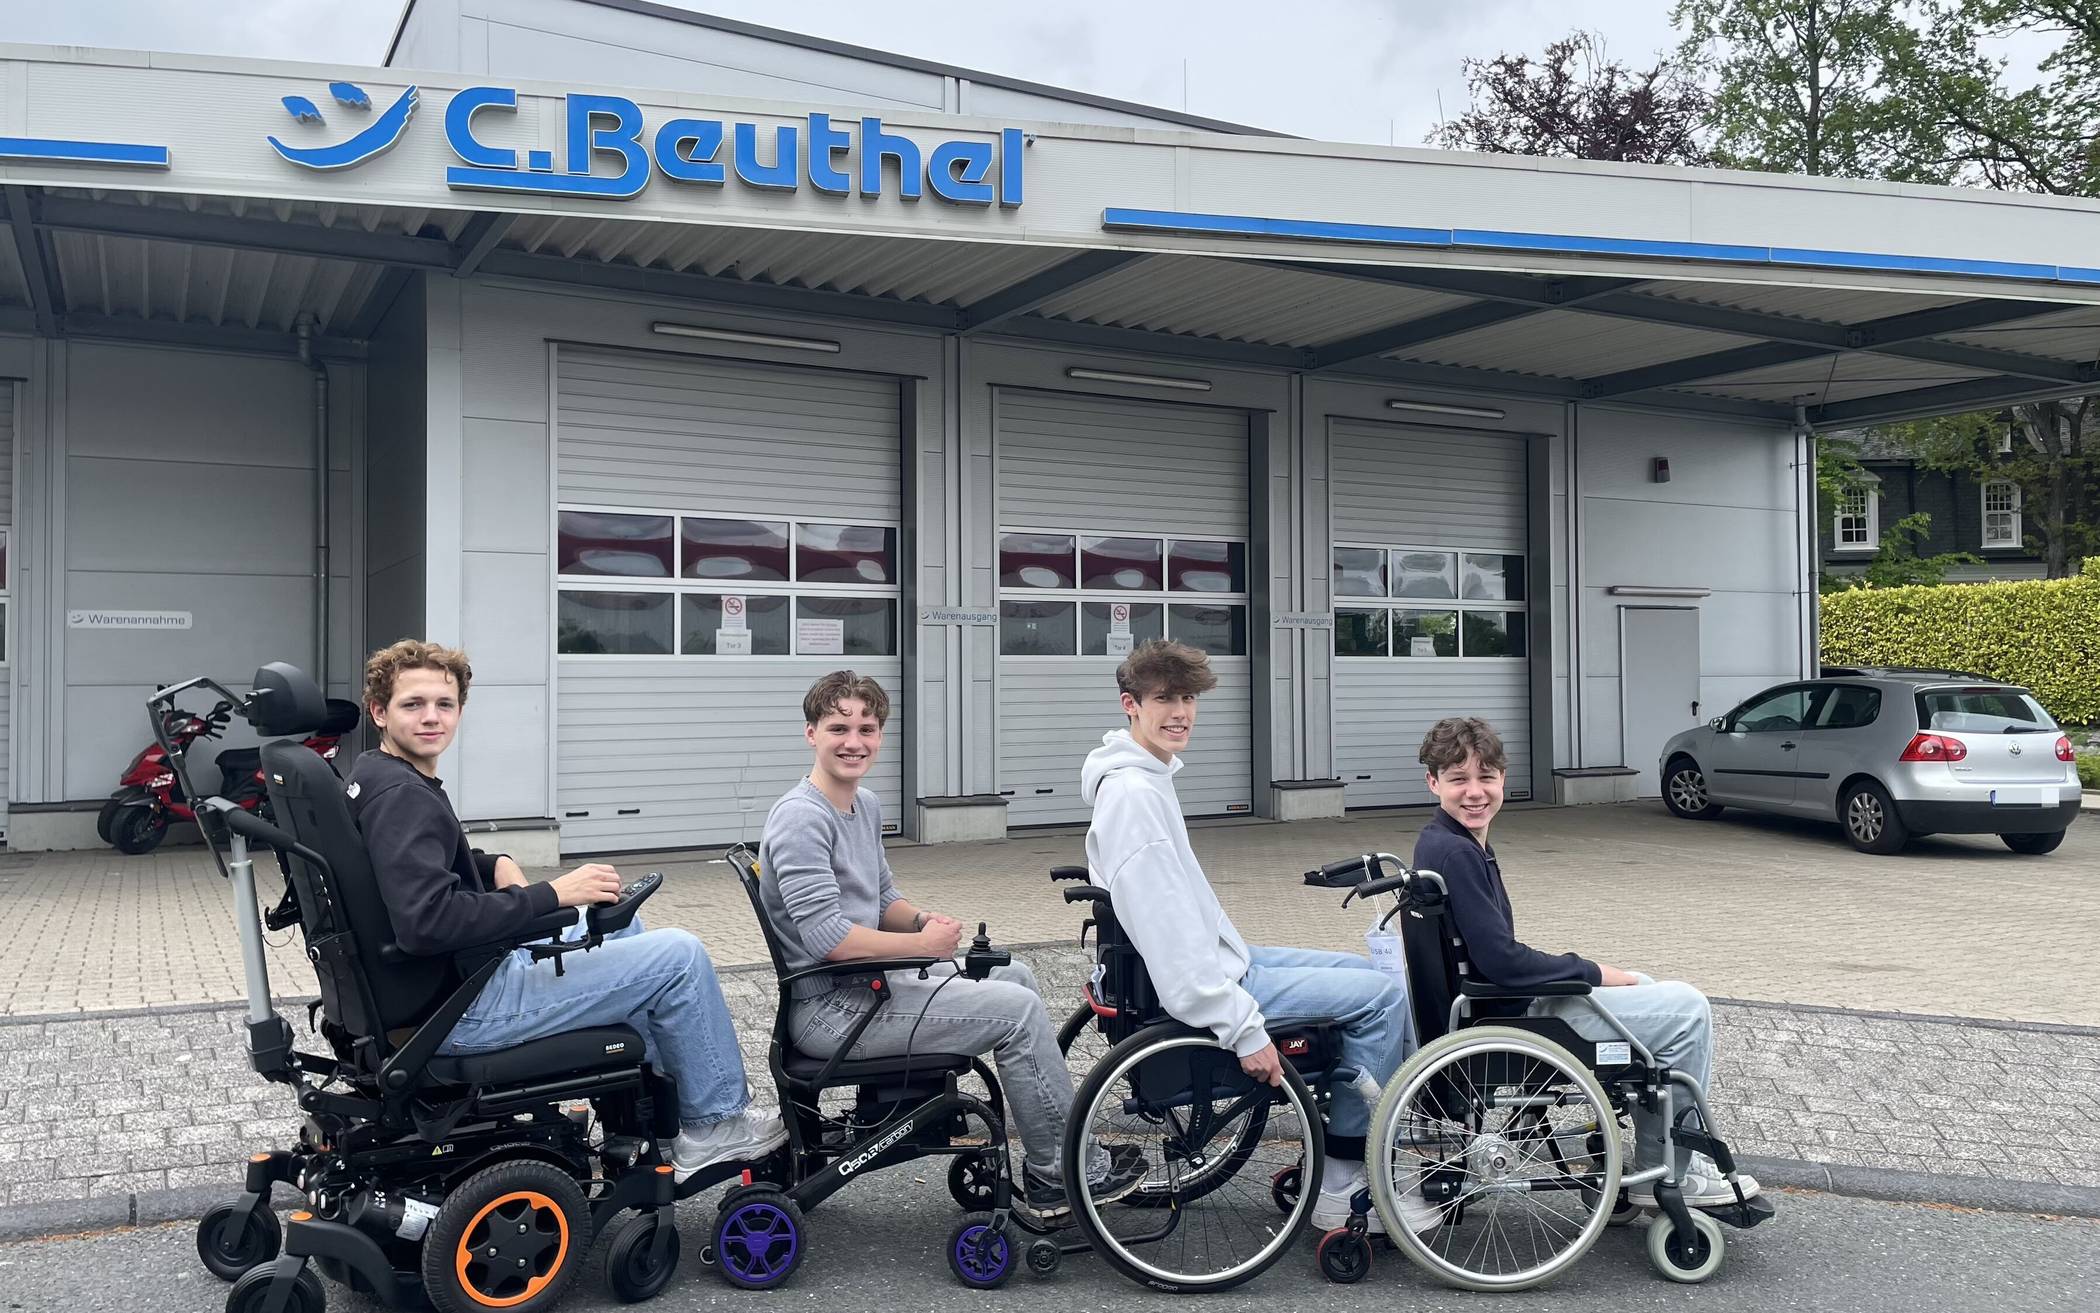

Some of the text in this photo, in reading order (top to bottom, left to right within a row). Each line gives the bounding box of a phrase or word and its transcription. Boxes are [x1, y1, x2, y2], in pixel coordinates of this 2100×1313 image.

[444, 86, 1024, 209] C.Beuthel
[88, 614, 186, 625] Warenannahme
[932, 611, 998, 623] Warenausgang
[1281, 615, 1333, 626] Warenausgang
[1289, 1040, 1305, 1049] JAY
[880, 1123, 912, 1150] carbon
